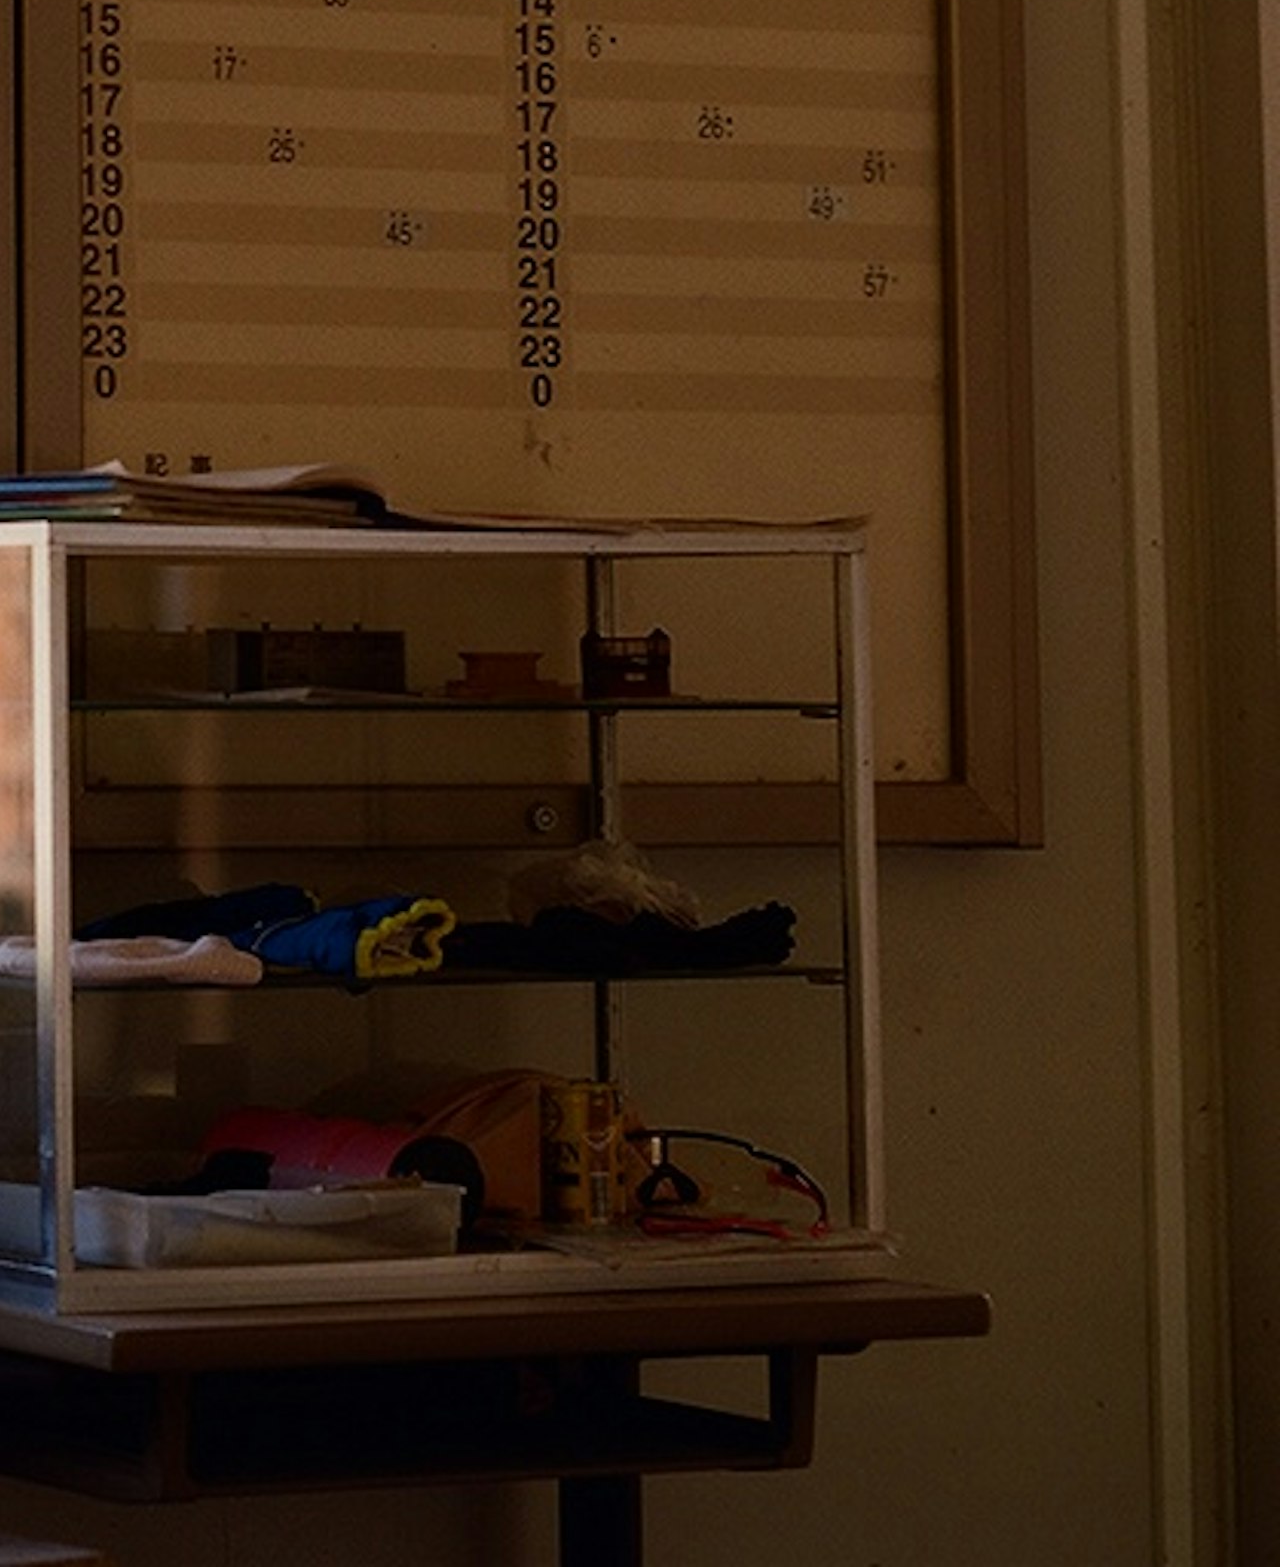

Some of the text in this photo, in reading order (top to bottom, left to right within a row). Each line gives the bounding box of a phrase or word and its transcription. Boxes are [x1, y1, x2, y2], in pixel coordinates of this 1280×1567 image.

[79, 2, 119, 36] 15
[515, 22, 601, 58] 15 6
[79, 42, 236, 79] 16 17
[515, 61, 555, 94] 16
[79, 82, 121, 116] 17
[516, 101, 724, 138] 17 26
[79, 123, 295, 162] 18 25
[517, 139, 886, 183] 18 51
[79, 163, 122, 197] 19
[518, 178, 557, 211] 19
[79, 202, 412, 245] 20 45
[518, 217, 558, 250] 20
[79, 242, 119, 277] 21
[518, 256, 888, 297] 21 57
[80, 283, 125, 318] 22
[519, 295, 560, 328] 22
[81, 323, 126, 358] 23
[519, 334, 560, 367] 23
[94, 364, 115, 398] 0
[531, 373, 551, 406] 0
